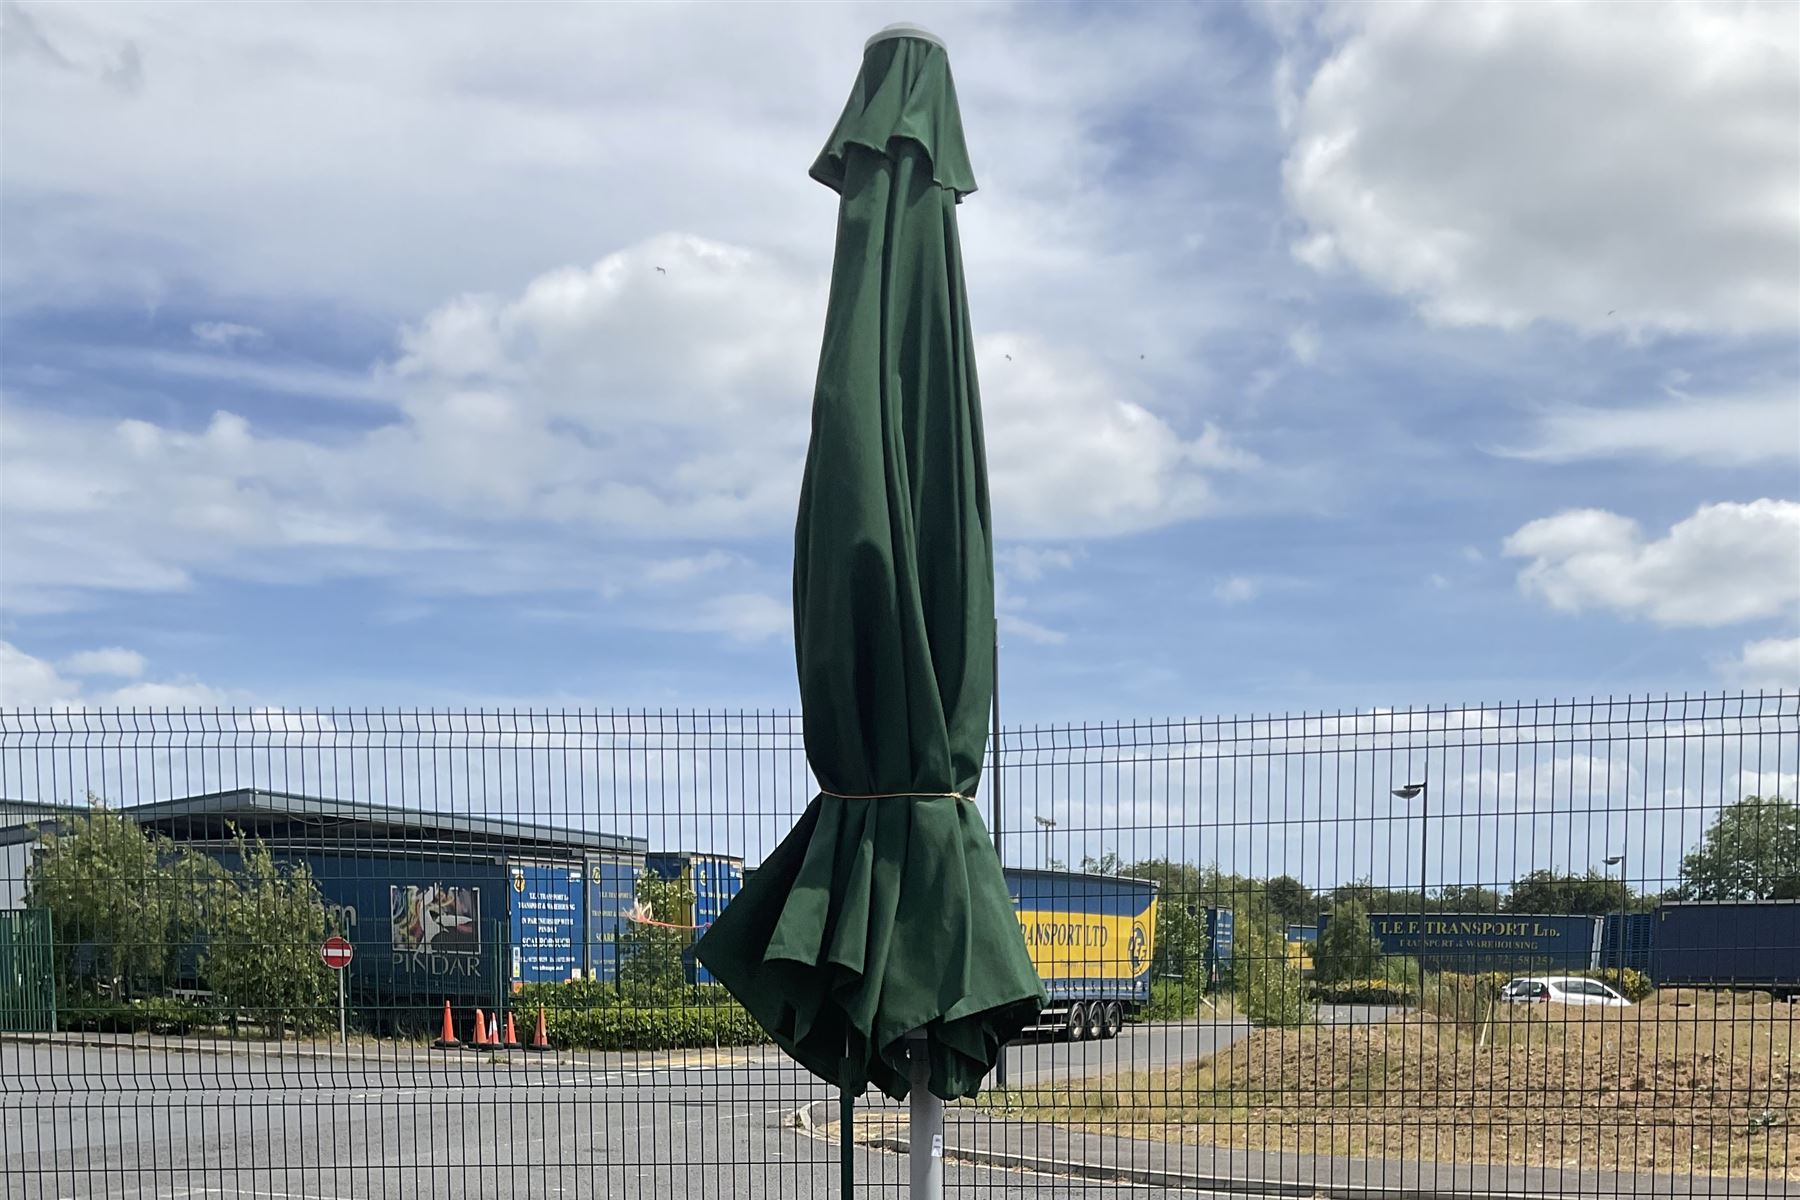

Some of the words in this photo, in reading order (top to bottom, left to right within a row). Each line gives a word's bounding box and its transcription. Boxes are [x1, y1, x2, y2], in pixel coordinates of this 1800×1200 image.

[1020, 923, 1082, 947] RANSPORT
[1086, 924, 1108, 948] LTD
[1424, 921, 1529, 936] TRANSPORT
[1400, 939, 1454, 948] TRASPORT
[392, 952, 481, 976] PINDAR
